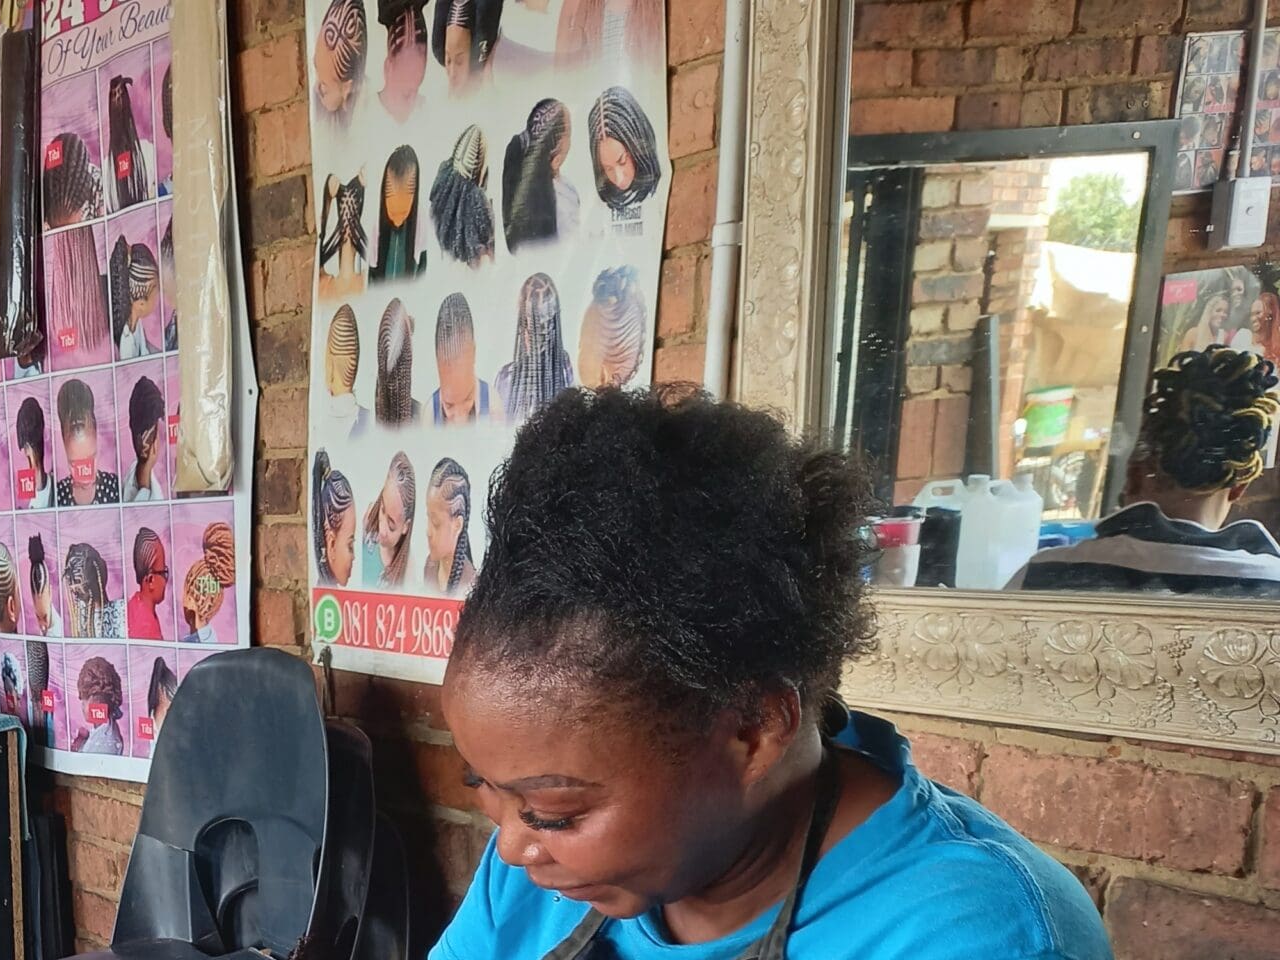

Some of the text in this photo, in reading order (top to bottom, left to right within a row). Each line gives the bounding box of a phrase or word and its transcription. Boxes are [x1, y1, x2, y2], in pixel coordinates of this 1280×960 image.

[42, 0, 85, 42] 24
[47, 38, 71, 77] Of
[73, 26, 116, 72] Your
[119, 1, 172, 42] Beau
[60, 334, 75, 347] Tibi
[77, 465, 92, 476] Tibi
[21, 475, 34, 492] Tibi
[343, 600, 370, 647] 081
[375, 604, 407, 653] 824
[91, 709, 105, 719] Tibi
[141, 723, 153, 735] Tibi
